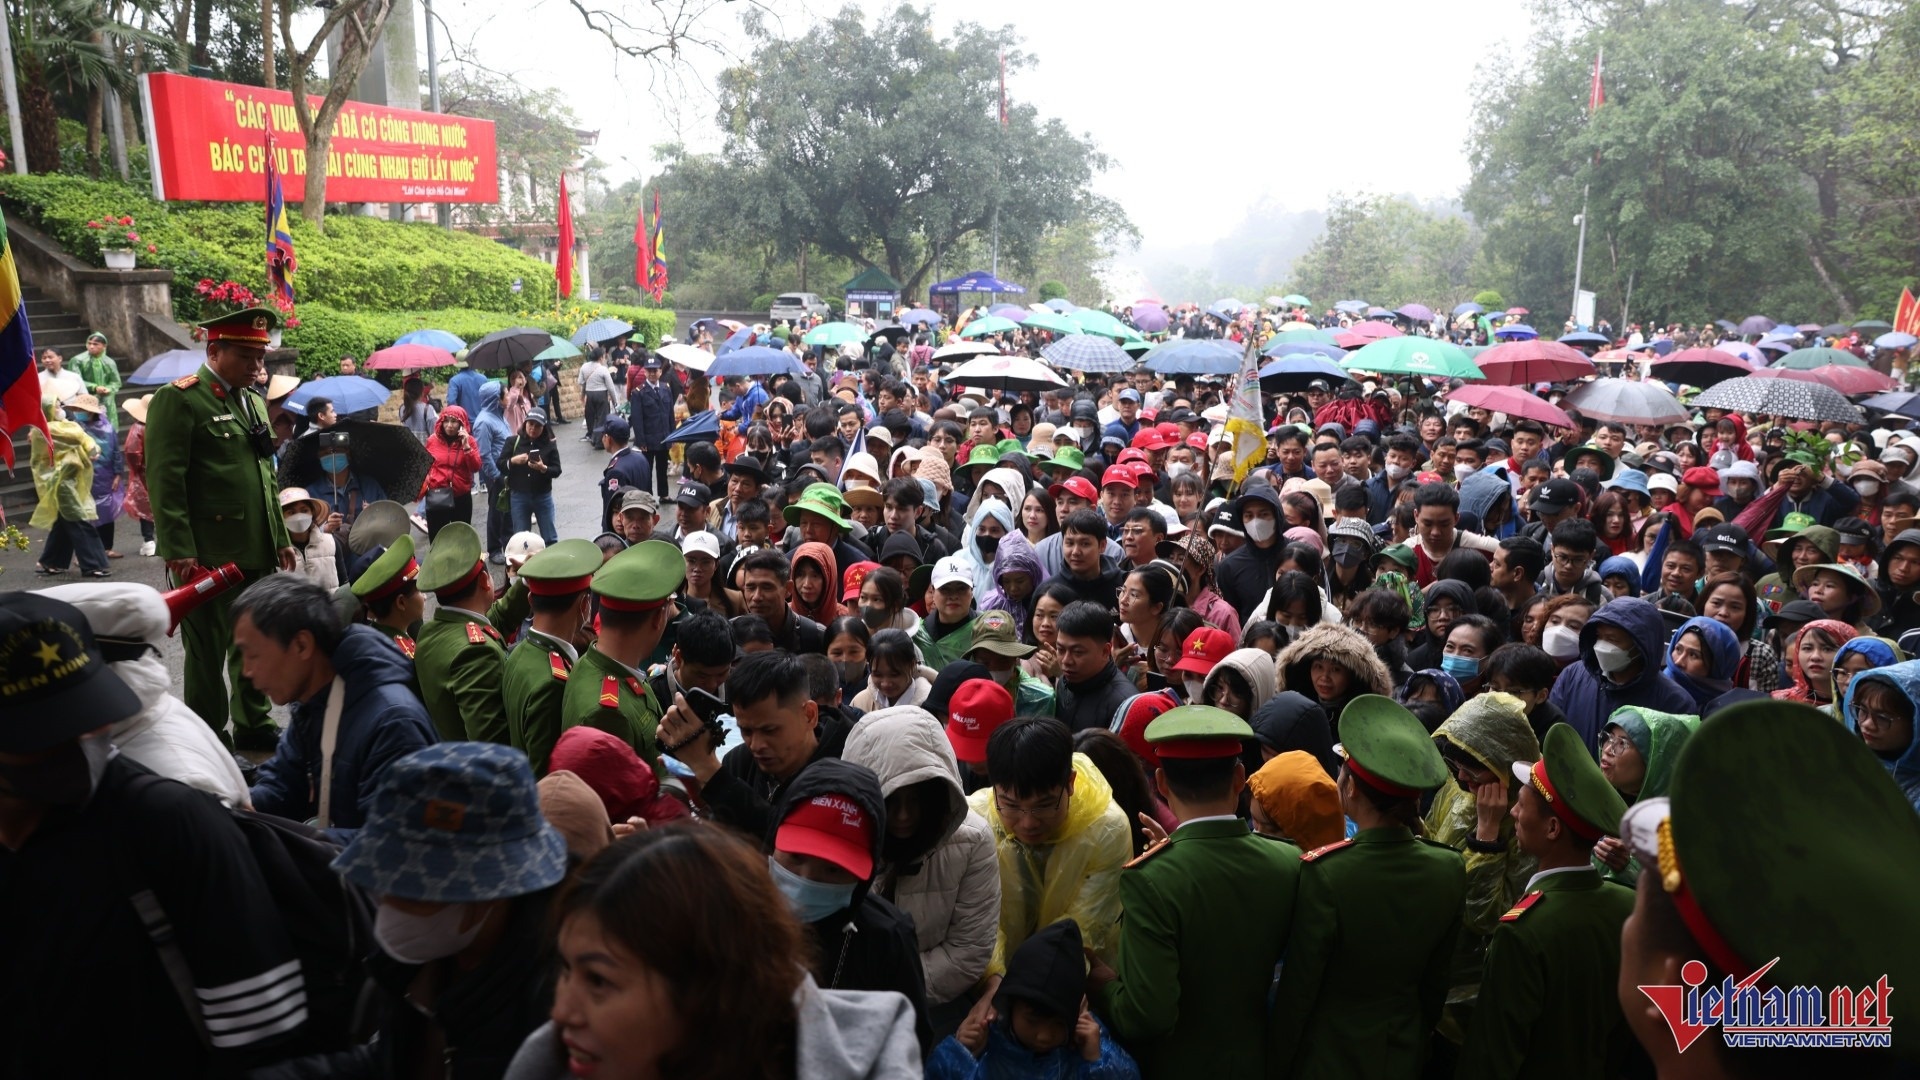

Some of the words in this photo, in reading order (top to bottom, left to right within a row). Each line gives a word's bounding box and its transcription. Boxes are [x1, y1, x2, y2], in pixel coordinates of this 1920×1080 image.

[270, 104, 300, 133] VUA
[341, 112, 358, 139] ĐÃ
[361, 113, 378, 141] CÓ
[379, 115, 410, 143] CÔNG
[412, 121, 440, 149] DỰNG
[442, 121, 467, 149] NƯỚC
[209, 137, 244, 173] BÁC
[290, 148, 307, 175] TA
[344, 149, 378, 179] CÙNG
[380, 154, 409, 181] NHAU
[411, 155, 429, 182] GIỮ
[430, 152, 449, 182] LẤY
[832, 799, 858, 815] XANH
